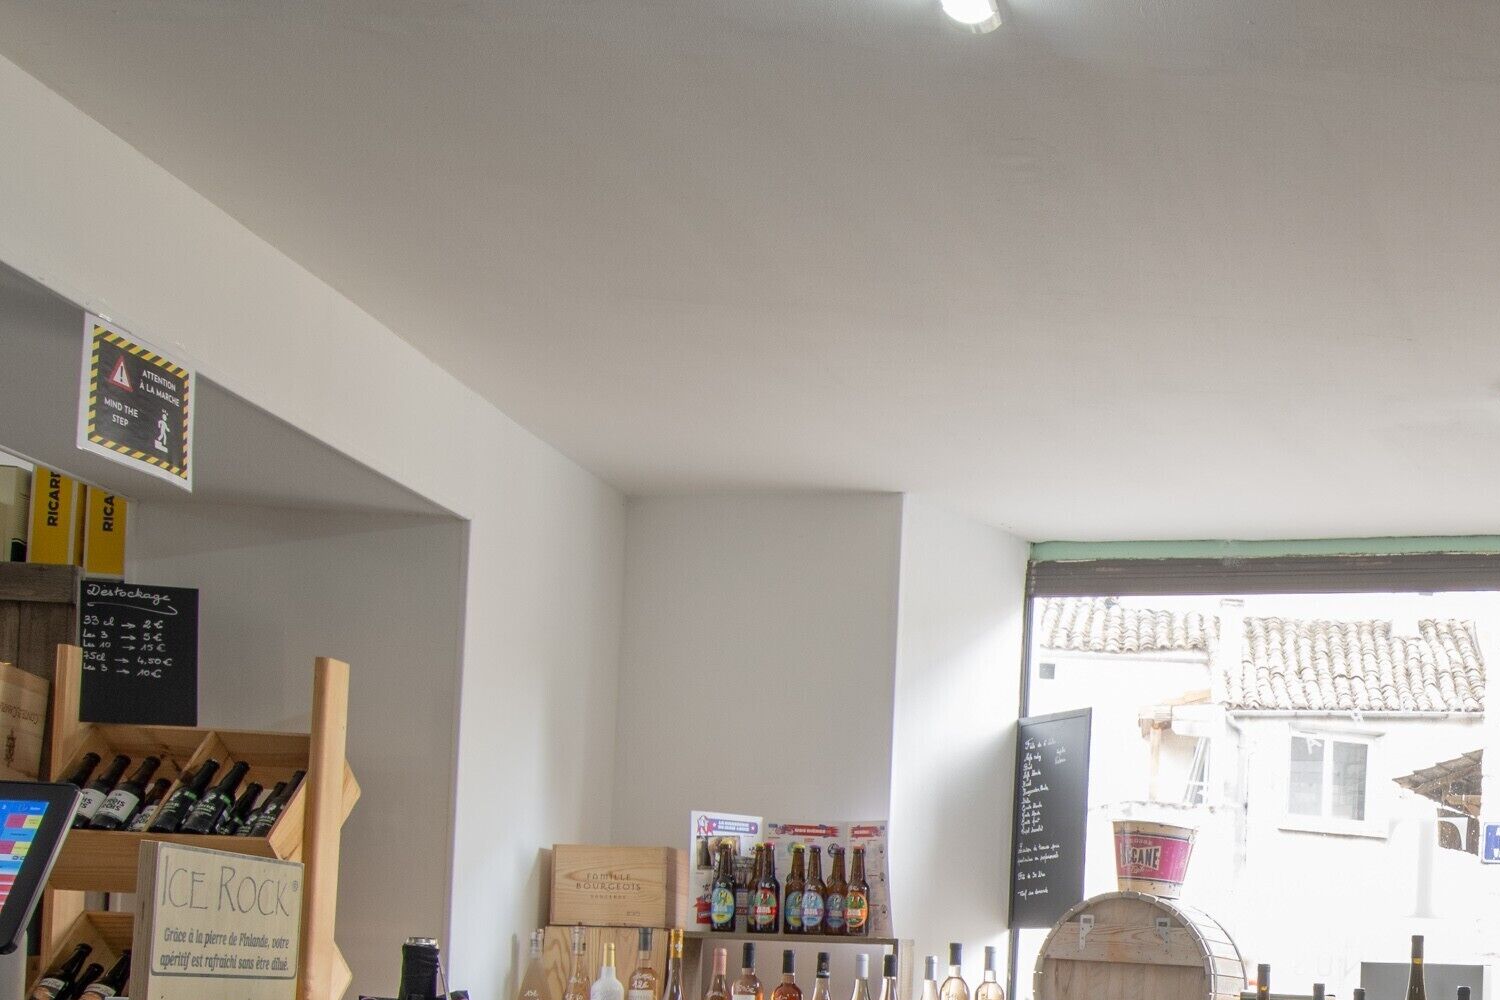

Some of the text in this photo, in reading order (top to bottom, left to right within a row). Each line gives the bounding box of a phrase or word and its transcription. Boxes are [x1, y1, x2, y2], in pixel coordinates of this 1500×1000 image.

[142, 370, 176, 392] ATTENTION
[146, 386, 155, 395] LA
[156, 390, 180, 407] MARCHE
[104, 397, 139, 418] MIND THE
[112, 414, 129, 427] STEP
[83, 615, 99, 625] 33
[161, 856, 289, 917] ICE ROCK
[576, 882, 641, 891] BOURGEOIS
[586, 873, 631, 881] FAMILLE
[164, 928, 186, 943] Grâce
[195, 929, 203, 943] la
[204, 931, 227, 948] pierre
[229, 932, 237, 946] de
[272, 937, 289, 949] votre
[160, 951, 190, 970] apéritif
[191, 954, 202, 967] est
[238, 957, 254, 970] sans
[255, 955, 270, 971] être
